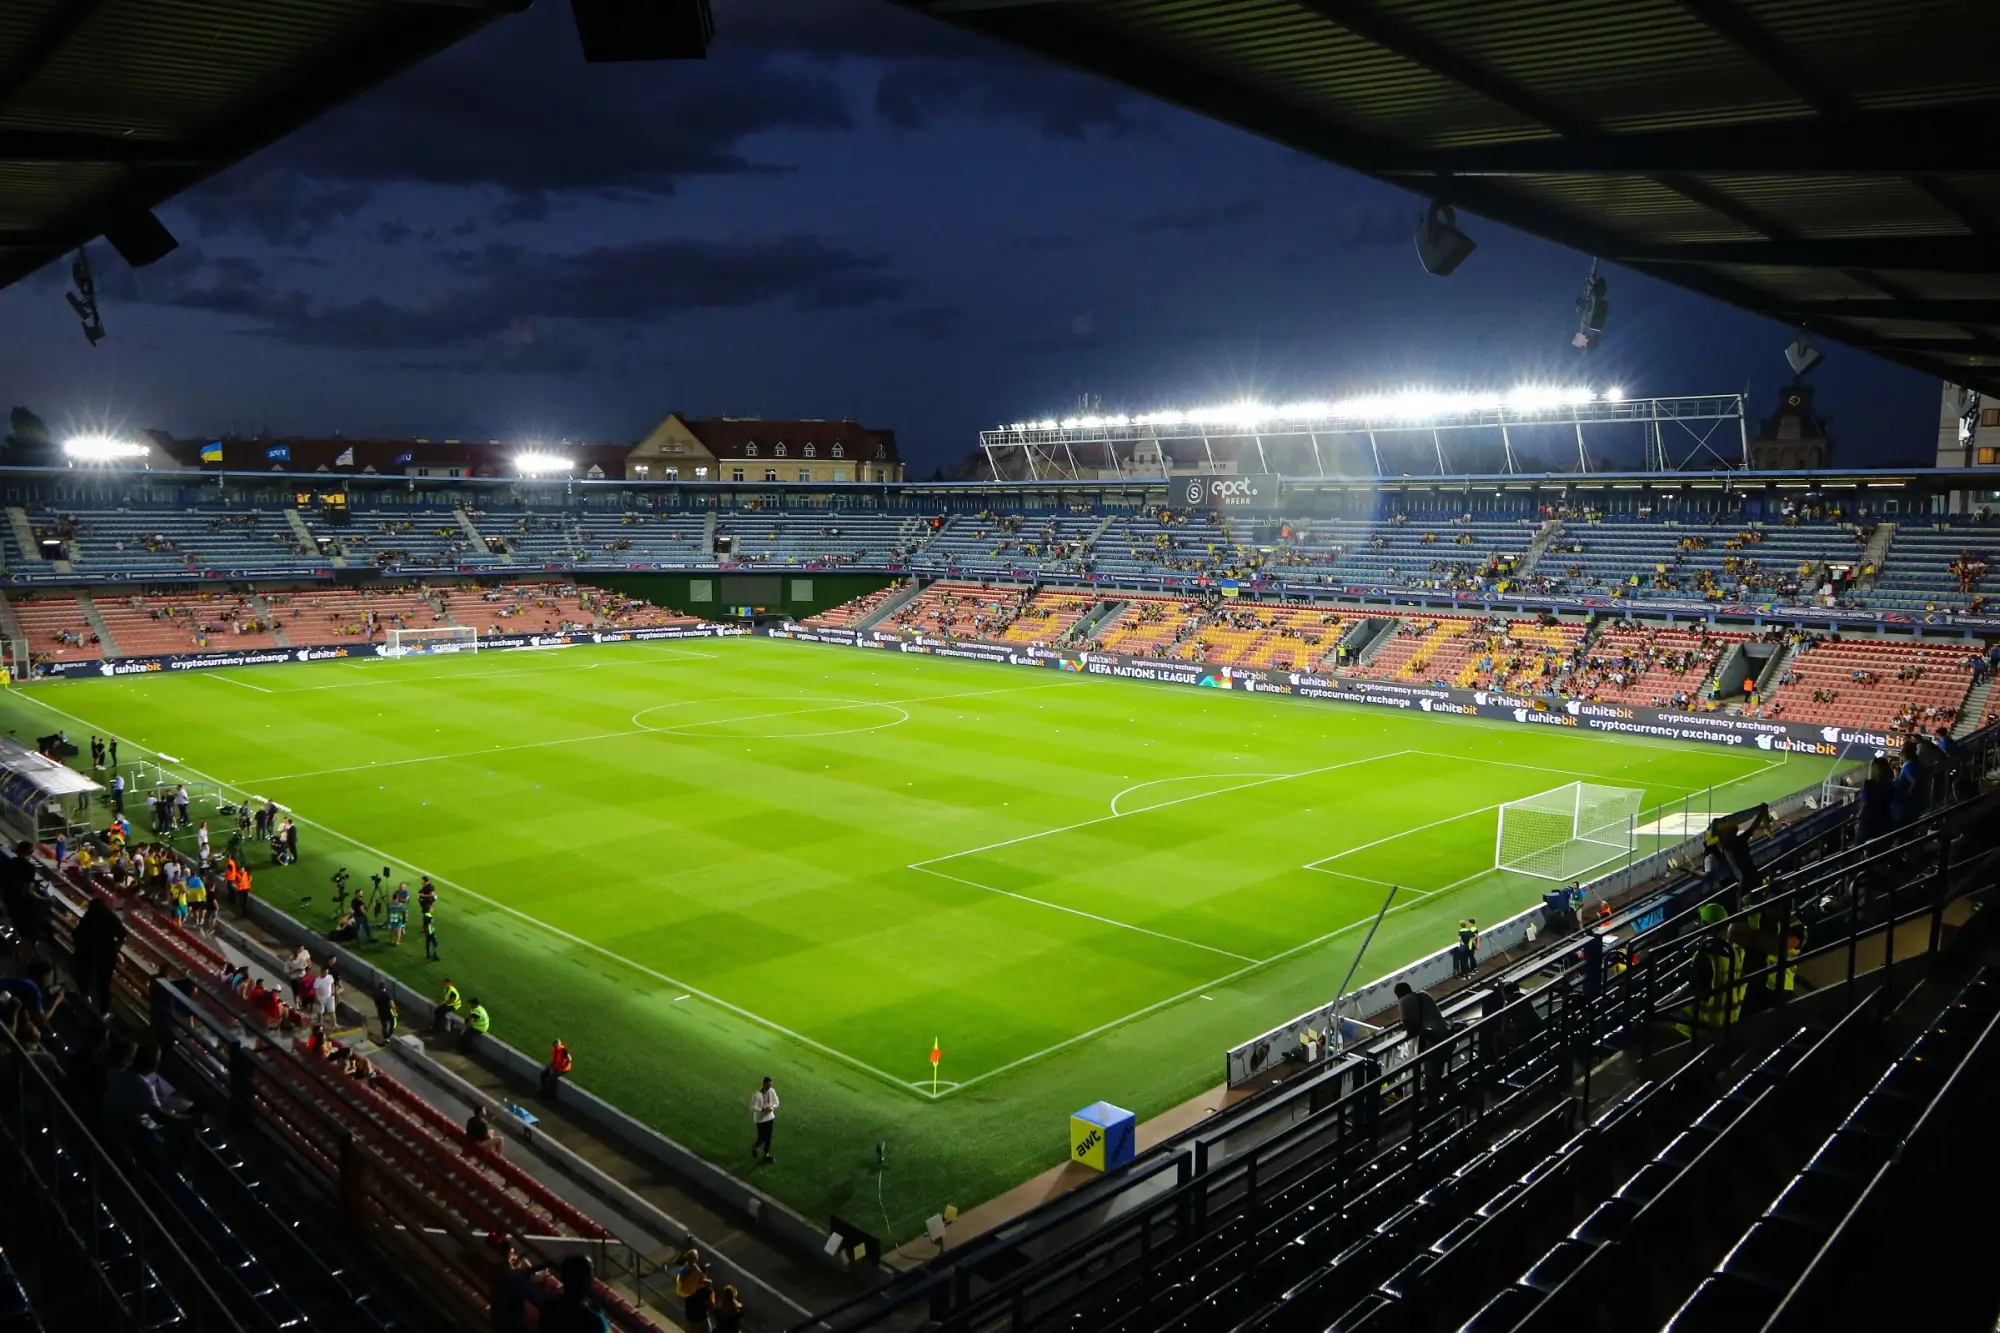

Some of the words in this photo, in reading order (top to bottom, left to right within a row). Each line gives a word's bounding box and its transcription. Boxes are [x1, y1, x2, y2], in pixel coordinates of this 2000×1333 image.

[540, 636, 572, 645] whitebit
[602, 633, 631, 641] whitebit
[637, 630, 683, 640] cryptocurrency
[684, 628, 711, 637] exchange
[490, 638, 524, 648] exchange
[957, 641, 991, 651] cryptocurrency
[990, 645, 1013, 653] exchange
[171, 655, 244, 670] cryptocurrency
[245, 652, 289, 664] exchange
[310, 649, 348, 659] whitebit
[935, 648, 977, 659] cryptocurrency
[977, 652, 1004, 663] exchange
[1034, 650, 1063, 659] whitebit
[115, 662, 162, 674] whitebit
[1018, 657, 1045, 667] whitebit
[1131, 659, 1174, 670] cryptocurrency
[1174, 663, 1203, 673] exchange
[1089, 663, 1112, 674] UEFA
[1113, 666, 1155, 680] NATIONS
[1158, 671, 1197, 684] LEAGUE
[1255, 682, 1292, 694] whitebit
[1300, 676, 1339, 688] whitebit
[1300, 687, 1365, 703] cryptocurrency
[1366, 694, 1411, 708] exchange
[1356, 682, 1412, 696] cryptocurrency
[1412, 687, 1449, 699] exchange
[1433, 701, 1478, 715] whitebit
[1582, 705, 1634, 719] whitebit
[1528, 712, 1578, 727] whitebit
[1658, 712, 1735, 729] cryptocurrency
[1736, 721, 1787, 734] exchange
[1589, 719, 1680, 739] cryptocurrency
[1681, 729, 1743, 745] exchange
[1774, 739, 1837, 756] whitebit
[1076, 1129, 1102, 1157] awt
